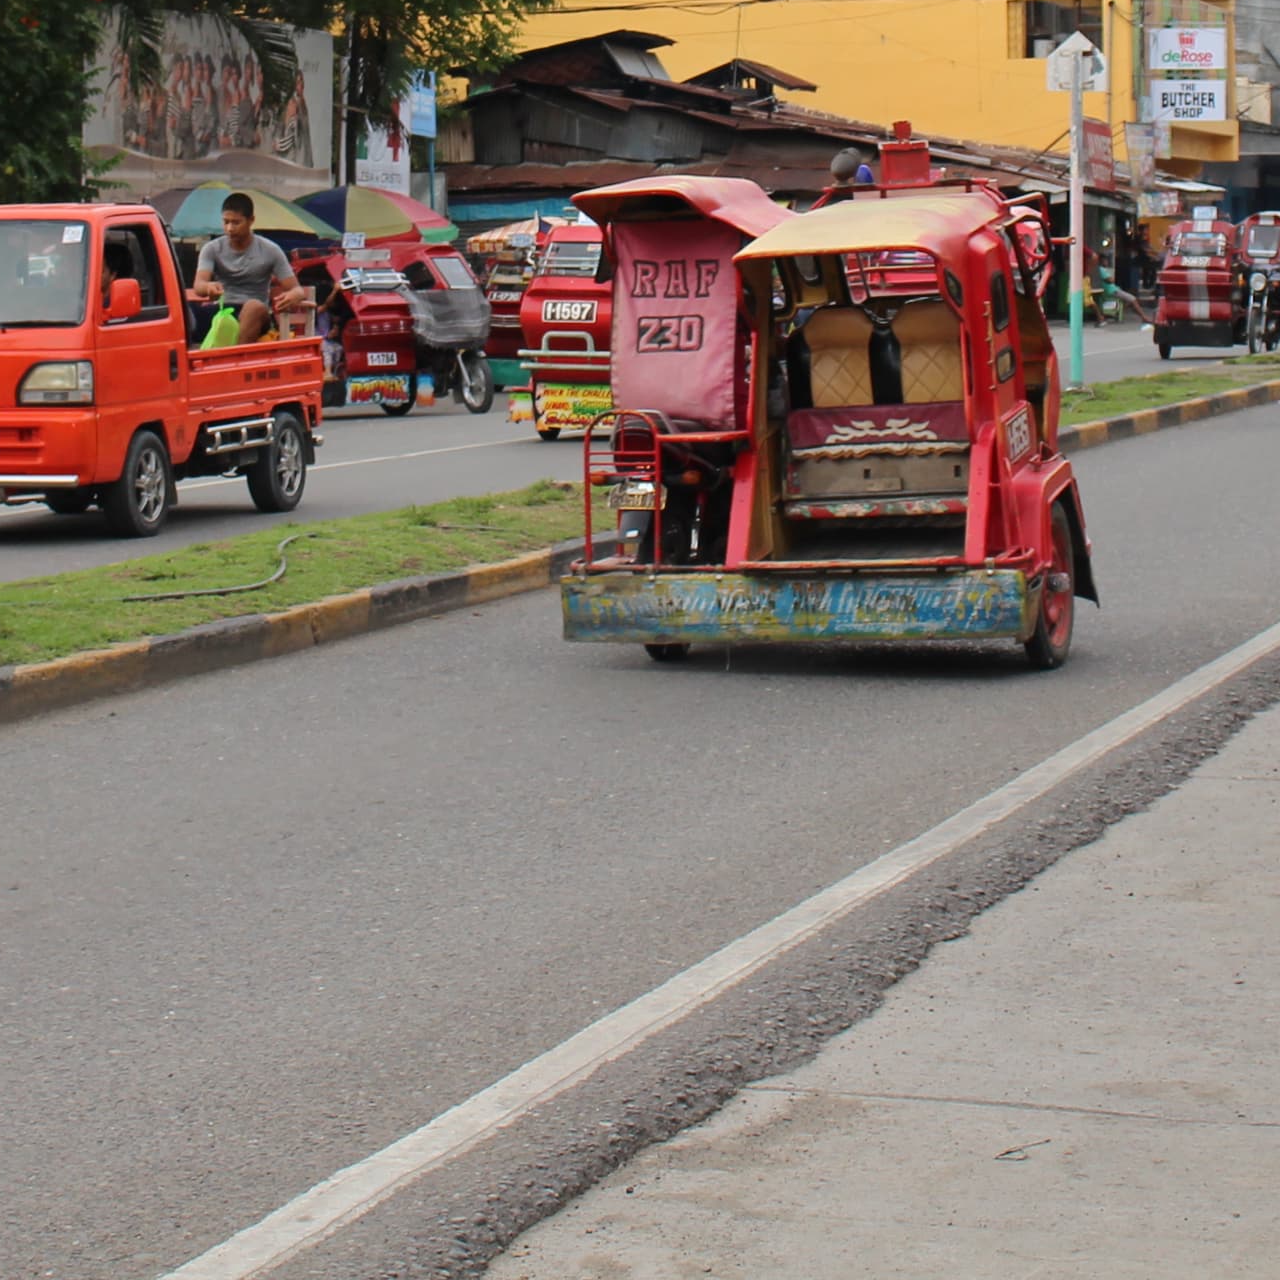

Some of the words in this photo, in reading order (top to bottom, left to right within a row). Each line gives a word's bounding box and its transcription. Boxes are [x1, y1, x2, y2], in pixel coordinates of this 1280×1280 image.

[1161, 49, 1213, 63] deRose
[1180, 83, 1195, 91] THE
[1161, 92, 1216, 108] BUTCHER
[1174, 107, 1204, 118] SHOP
[631, 259, 719, 298] RAF
